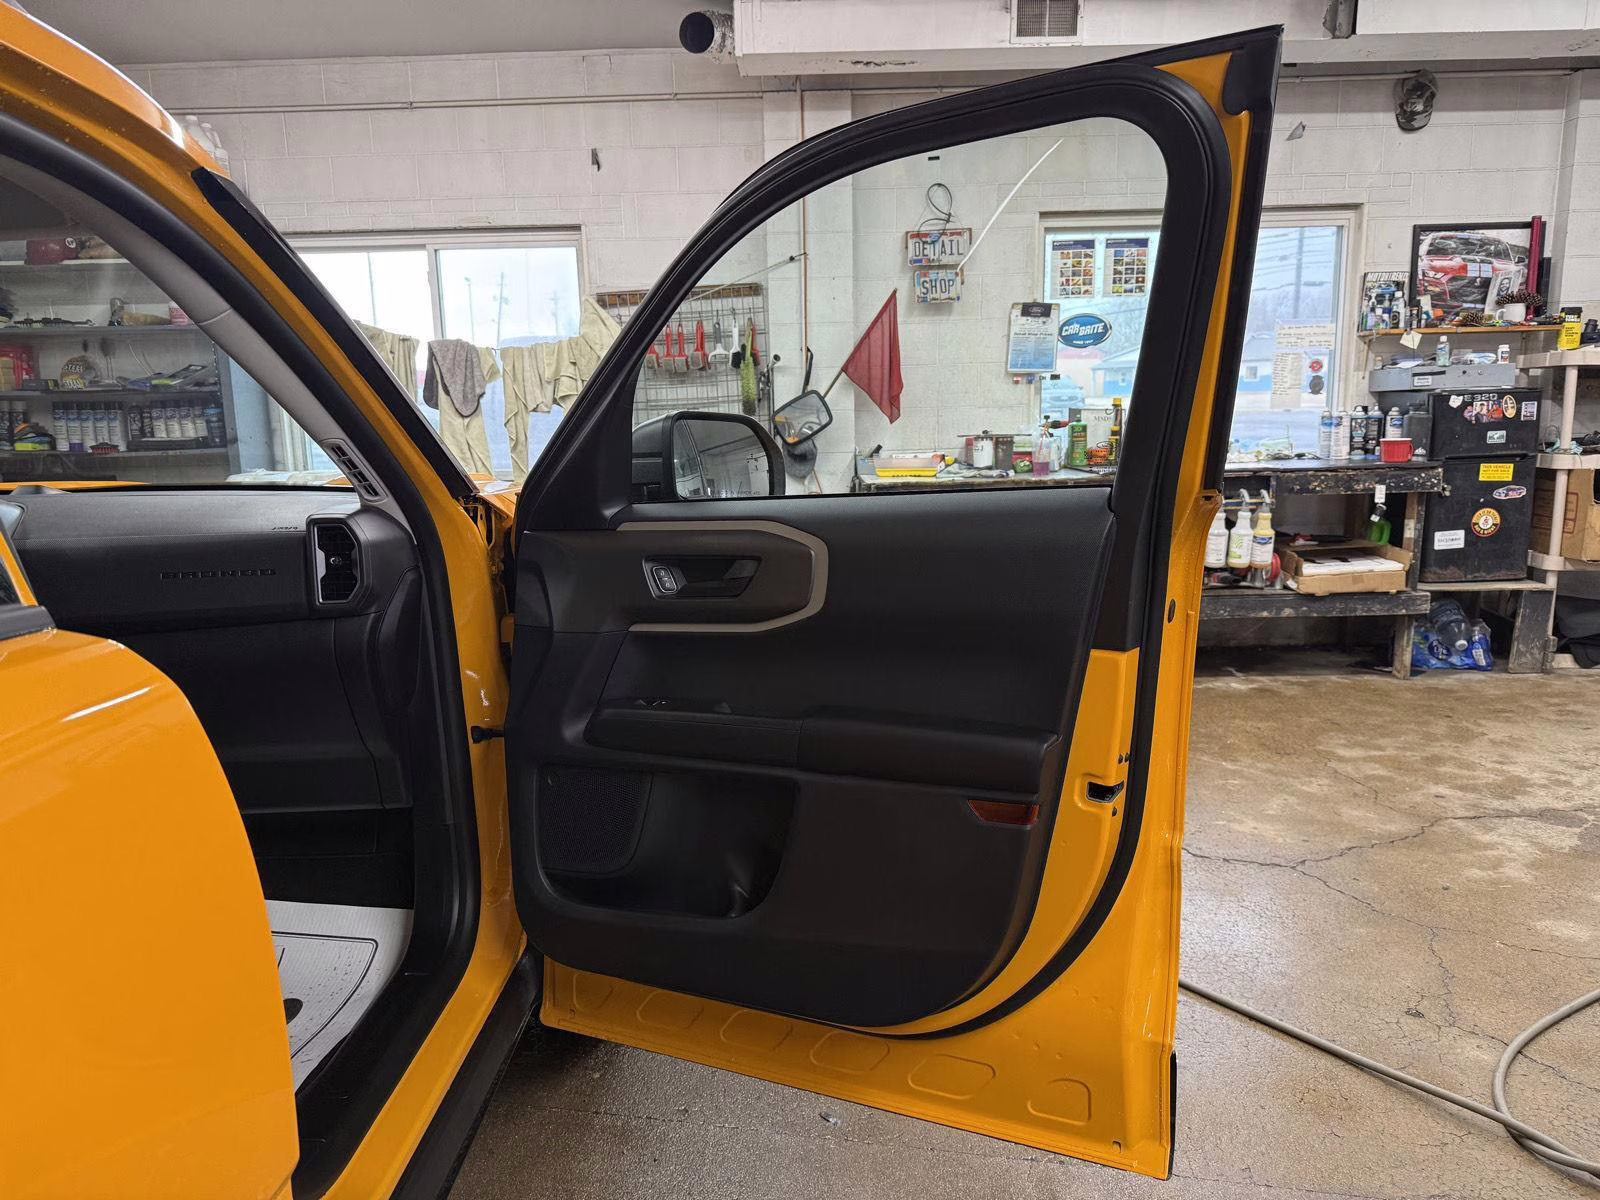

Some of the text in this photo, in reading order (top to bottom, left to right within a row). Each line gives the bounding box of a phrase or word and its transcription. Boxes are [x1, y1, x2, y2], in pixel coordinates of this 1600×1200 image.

[914, 239, 964, 257] DETAIL
[922, 279, 955, 295] SHOP
[1062, 322, 1105, 336] CAR BRITE
[160, 568, 276, 580] BRONCO
